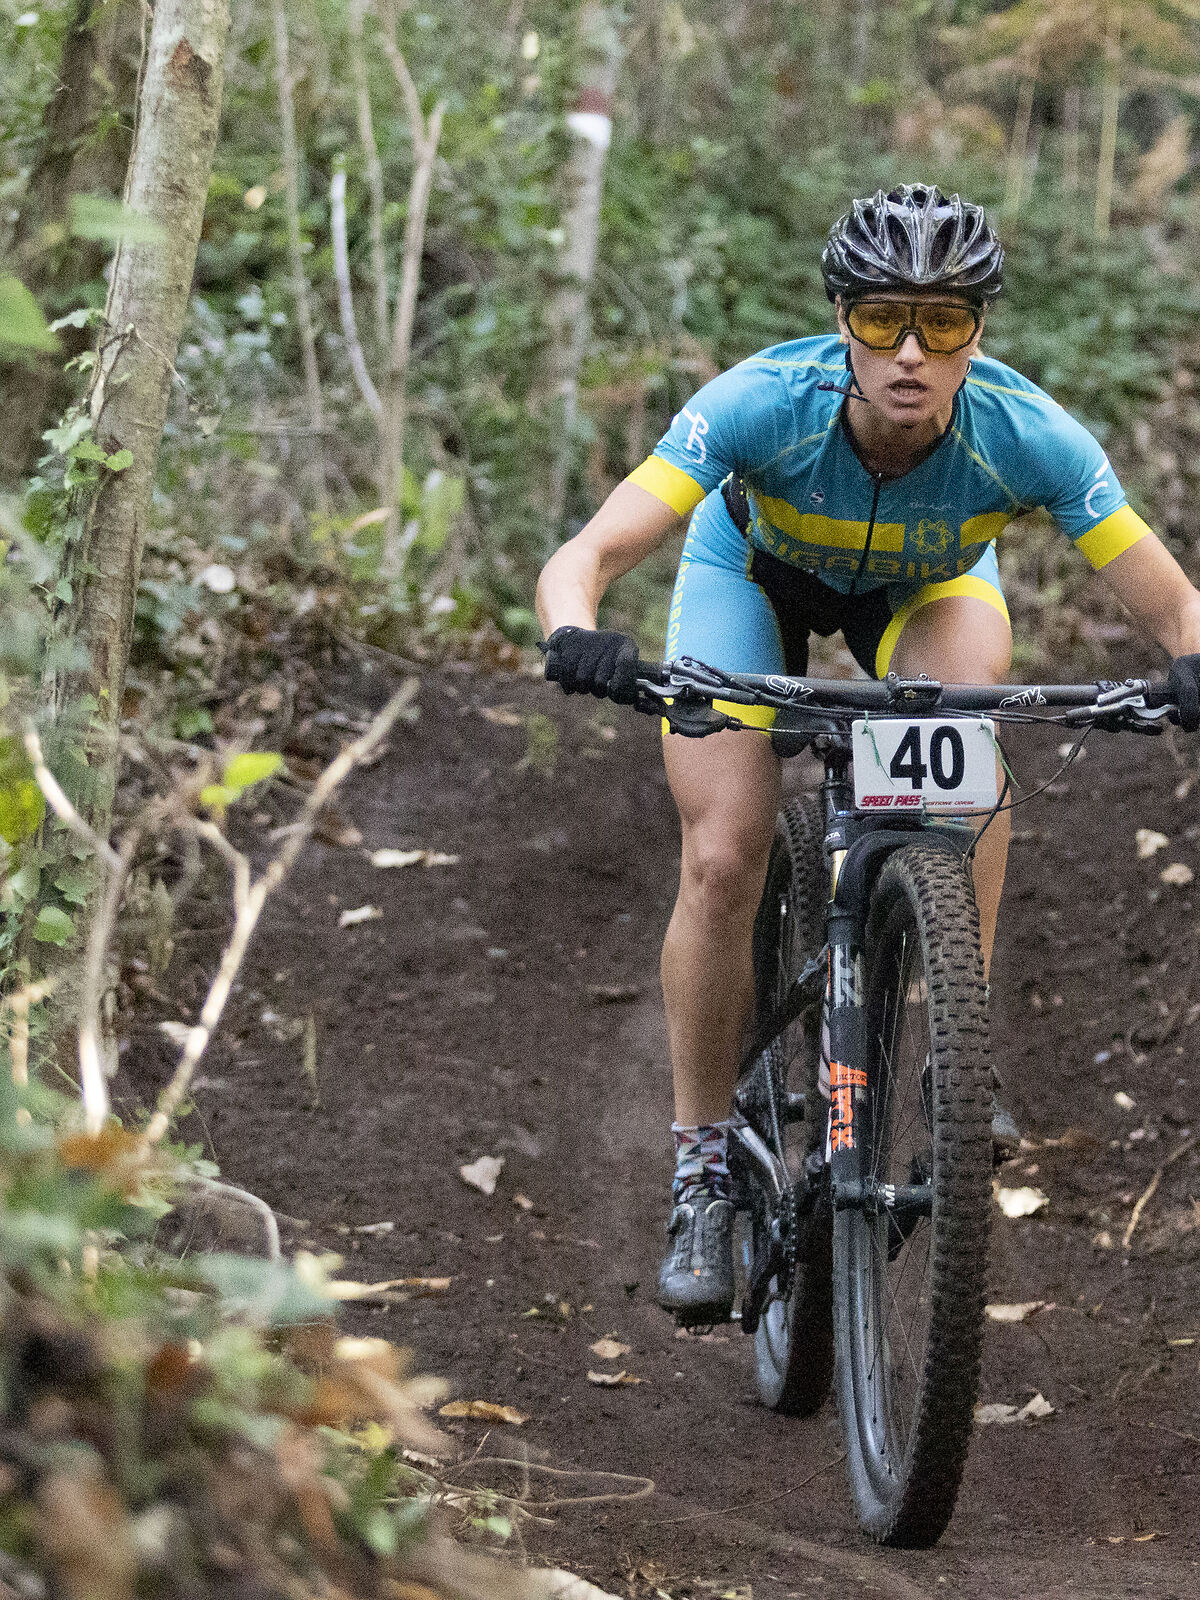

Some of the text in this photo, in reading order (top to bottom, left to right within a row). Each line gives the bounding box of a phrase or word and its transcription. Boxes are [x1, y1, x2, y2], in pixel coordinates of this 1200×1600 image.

[889, 725, 965, 790] 40
[860, 794, 922, 807] SPEED PASS
